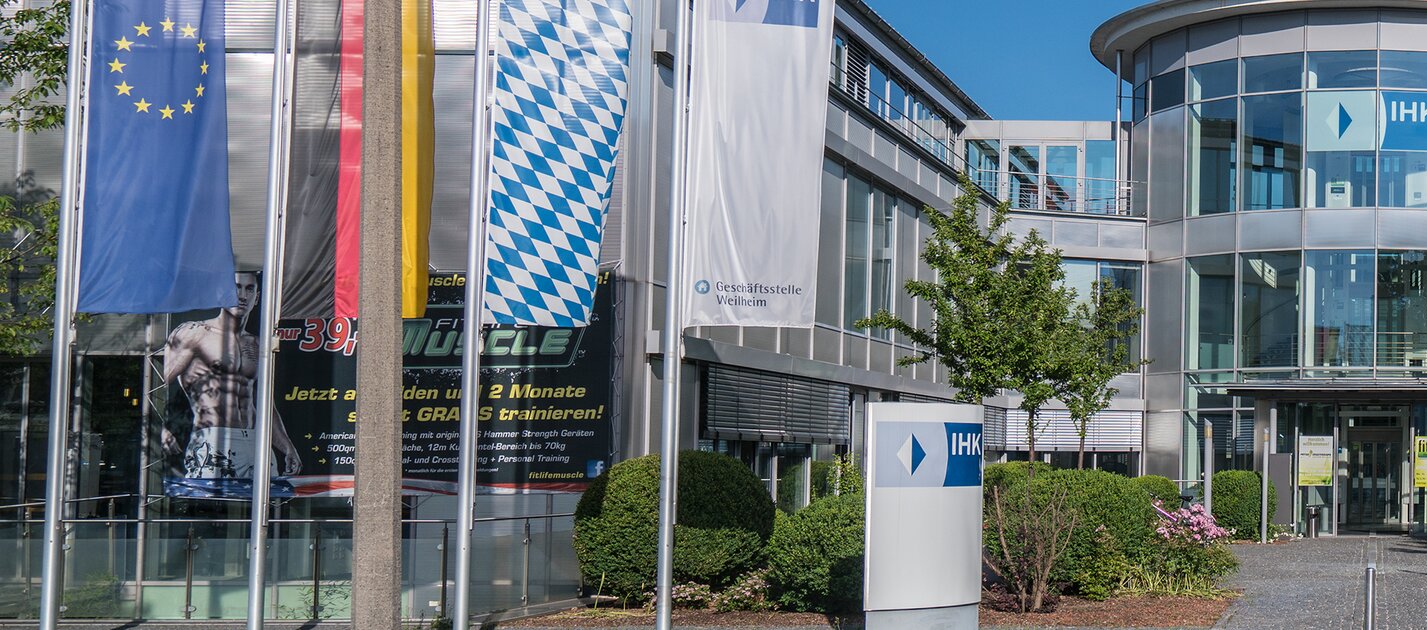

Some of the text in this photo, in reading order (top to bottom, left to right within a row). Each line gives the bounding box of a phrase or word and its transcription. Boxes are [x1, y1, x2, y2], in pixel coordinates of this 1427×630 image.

[716, 281, 802, 295] Geschäftsstelle
[716, 295, 767, 307] Weilheim
[299, 316, 358, 356] 39,
[284, 386, 339, 401] Jetzt
[488, 384, 504, 399] 2
[508, 383, 587, 399] Monate
[416, 406, 493, 422] GRAS
[498, 405, 605, 421] trainieren!
[318, 432, 356, 440] America
[419, 431, 434, 439] mit
[435, 431, 460, 441] origin
[483, 430, 520, 438] Hammer
[521, 429, 559, 440] Strength
[560, 429, 595, 437] Geräten
[427, 443, 447, 451] 12m
[529, 442, 541, 450] bis
[544, 442, 566, 451] 70kg
[951, 432, 981, 456] IHK
[413, 456, 431, 464] und
[497, 455, 534, 463] Personal
[537, 454, 570, 464] Training
[528, 471, 584, 479] fitlifemuscle
